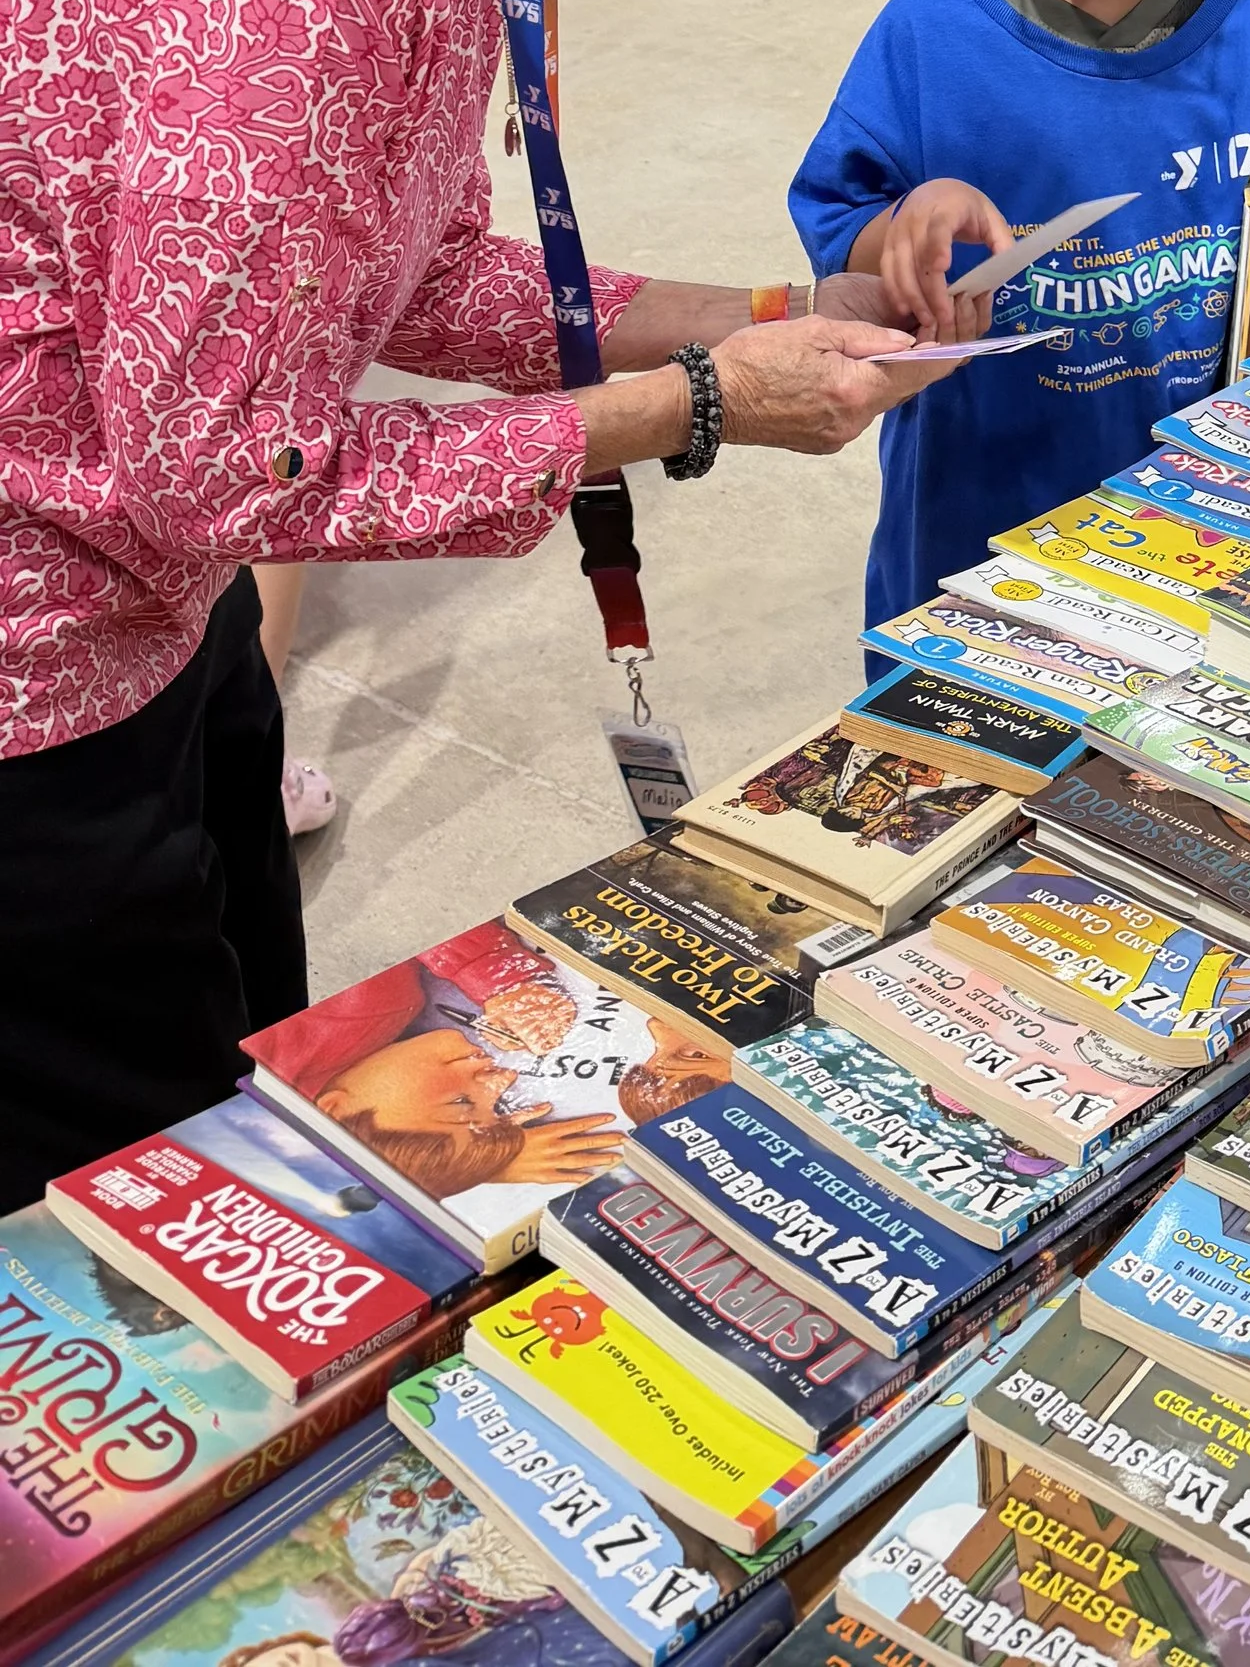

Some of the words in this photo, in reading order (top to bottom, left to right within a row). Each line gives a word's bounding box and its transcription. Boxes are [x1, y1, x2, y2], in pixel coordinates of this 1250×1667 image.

[1073, 249, 1135, 270] CHANGE
[1135, 238, 1159, 257] THE
[1161, 225, 1214, 247] WORLD.
[911, 677, 935, 690] OF
[906, 692, 974, 721] TWAIN
[935, 682, 1041, 722] ADVENTURES
[974, 712, 1047, 741] MARK
[1040, 717, 1074, 734] THE
[1047, 775, 1169, 835] SCHOOL
[1126, 797, 1203, 839] CHILDREN
[1204, 831, 1241, 855] THE
[651, 890, 676, 908] Ellen
[675, 901, 694, 919] and
[691, 899, 722, 920] Slaves
[1027, 887, 1112, 938] CANYON
[1093, 892, 1154, 930] GRAB
[595, 886, 737, 974] Freedom
[694, 912, 726, 937] William
[720, 915, 759, 941] Fugitive
[723, 931, 735, 943] of
[562, 904, 676, 982] Tickets
[736, 936, 763, 958] Story
[1111, 921, 1191, 973] GRAND
[761, 953, 783, 970] True
[783, 964, 803, 980] The
[897, 948, 966, 991] CRIME
[671, 968, 745, 1023] Two
[733, 966, 780, 1005] To
[961, 988, 1046, 1041] CASTLE
[517, 1054, 627, 1086] LOST
[720, 1104, 804, 1168] ISLAND
[134, 1153, 189, 1187] GERTRUDE
[143, 1149, 199, 1181] CHANDLER
[159, 1146, 204, 1174] WARNER
[91, 1188, 126, 1210] BOOK
[798, 1162, 925, 1254] INVISIBLE
[154, 1200, 385, 1327] BOXCAR
[597, 1180, 836, 1359] SURVIVED
[914, 1246, 945, 1270] THE
[276, 1317, 330, 1345] THE
[597, 1341, 641, 1382] Jokes!
[805, 1340, 867, 1381] I
[635, 1374, 664, 1409] 250
[657, 1402, 689, 1438] Over
[685, 1434, 747, 1483] Includes
[998, 1496, 1140, 1591] AUTHOR
[1016, 1558, 1170, 1661] ABSENT
